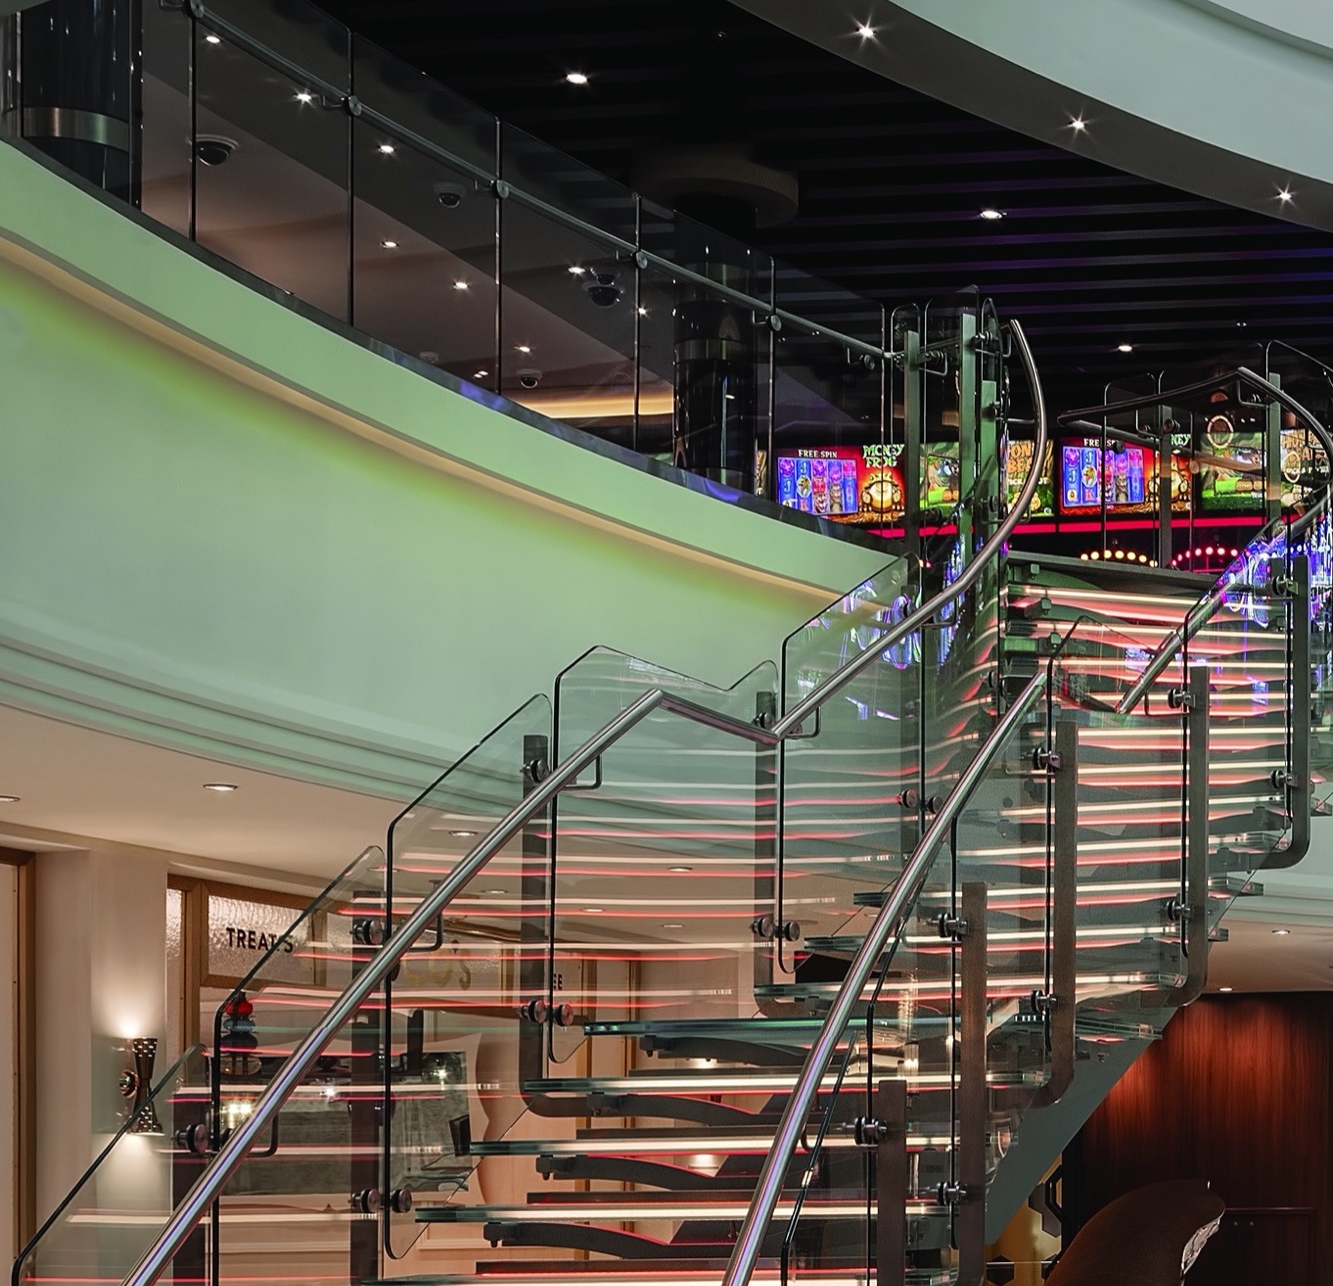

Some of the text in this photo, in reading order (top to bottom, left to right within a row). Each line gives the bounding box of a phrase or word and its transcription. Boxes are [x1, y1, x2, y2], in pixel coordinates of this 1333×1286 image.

[798, 449, 838, 459] FREE SPIN
[862, 444, 905, 459] MONEY
[865, 456, 898, 469] FROG
